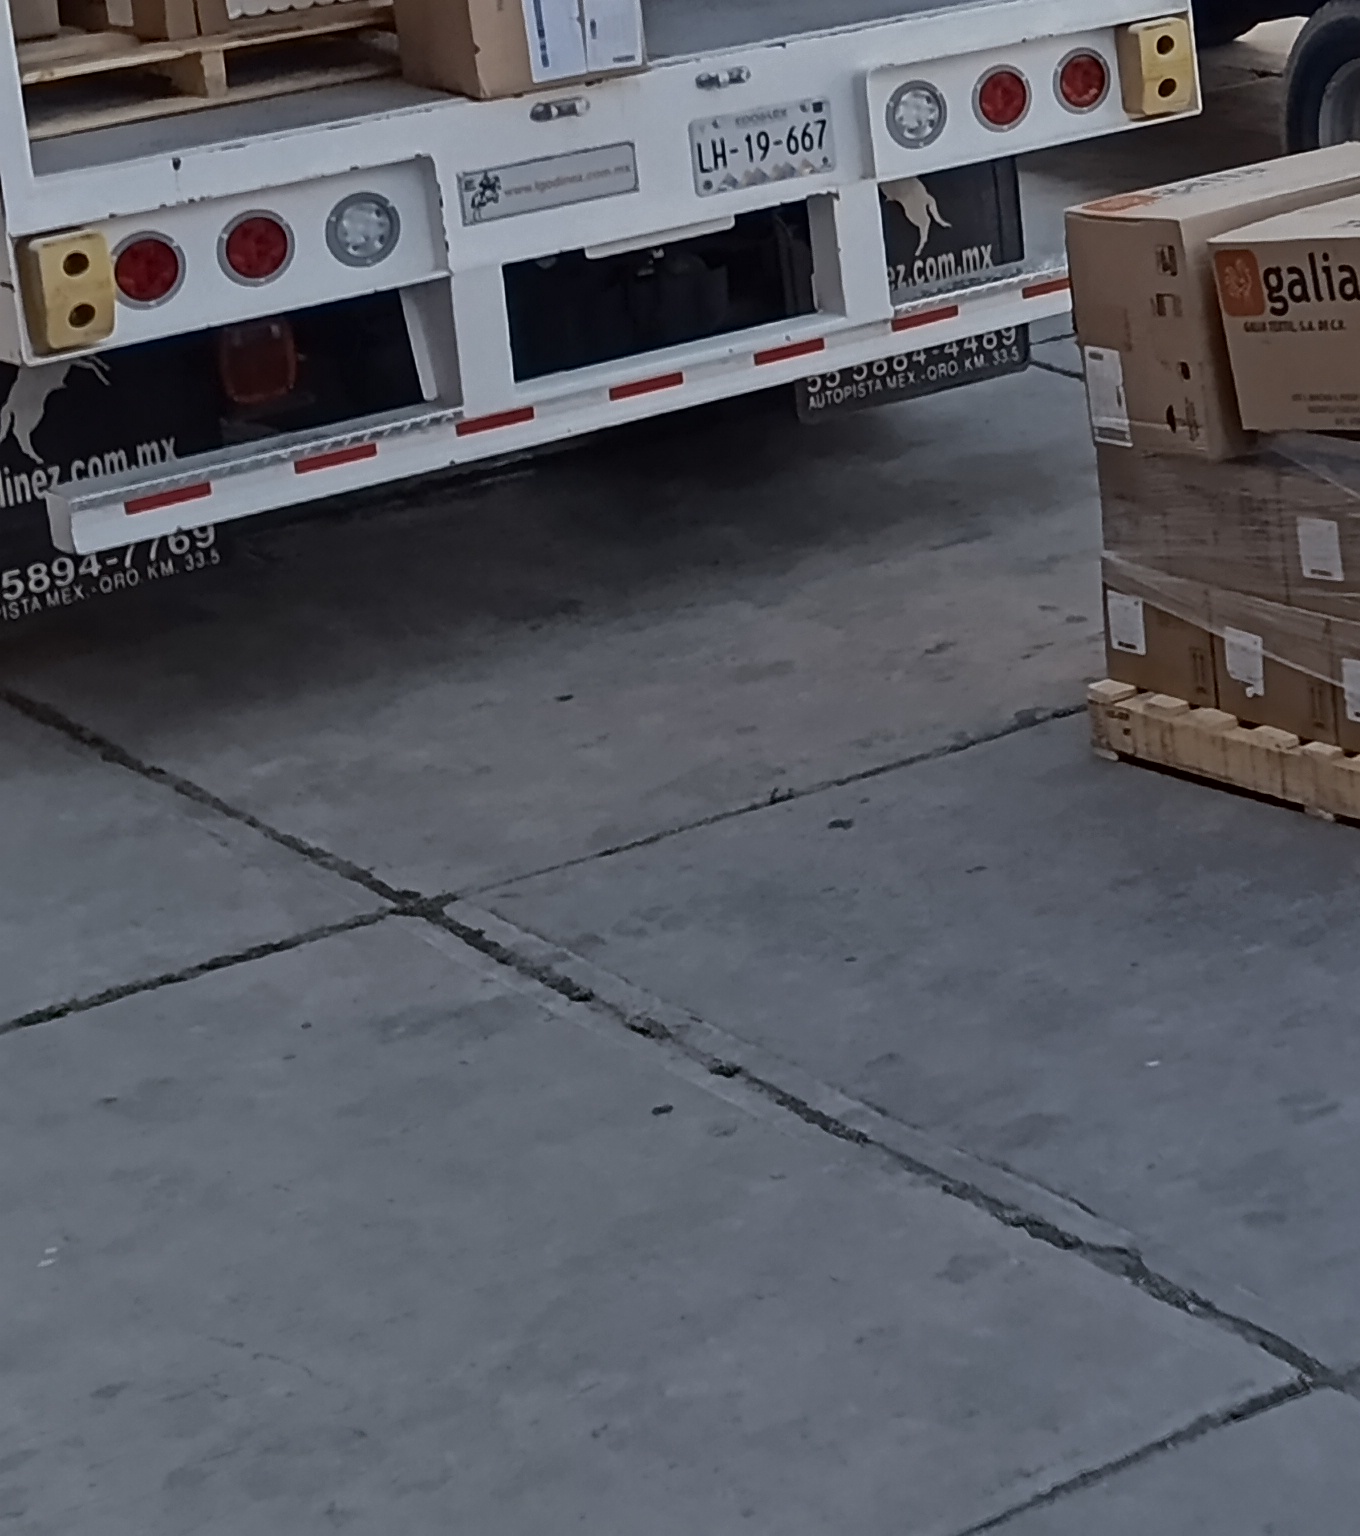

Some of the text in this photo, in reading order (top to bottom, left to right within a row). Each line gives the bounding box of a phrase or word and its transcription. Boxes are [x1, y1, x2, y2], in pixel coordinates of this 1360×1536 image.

[697, 119, 827, 174] LH-19-667
[808, 378, 883, 411] AUTOPISTA
[0, 594, 42, 621] ISTA
[185, 548, 221, 572] 33.5
